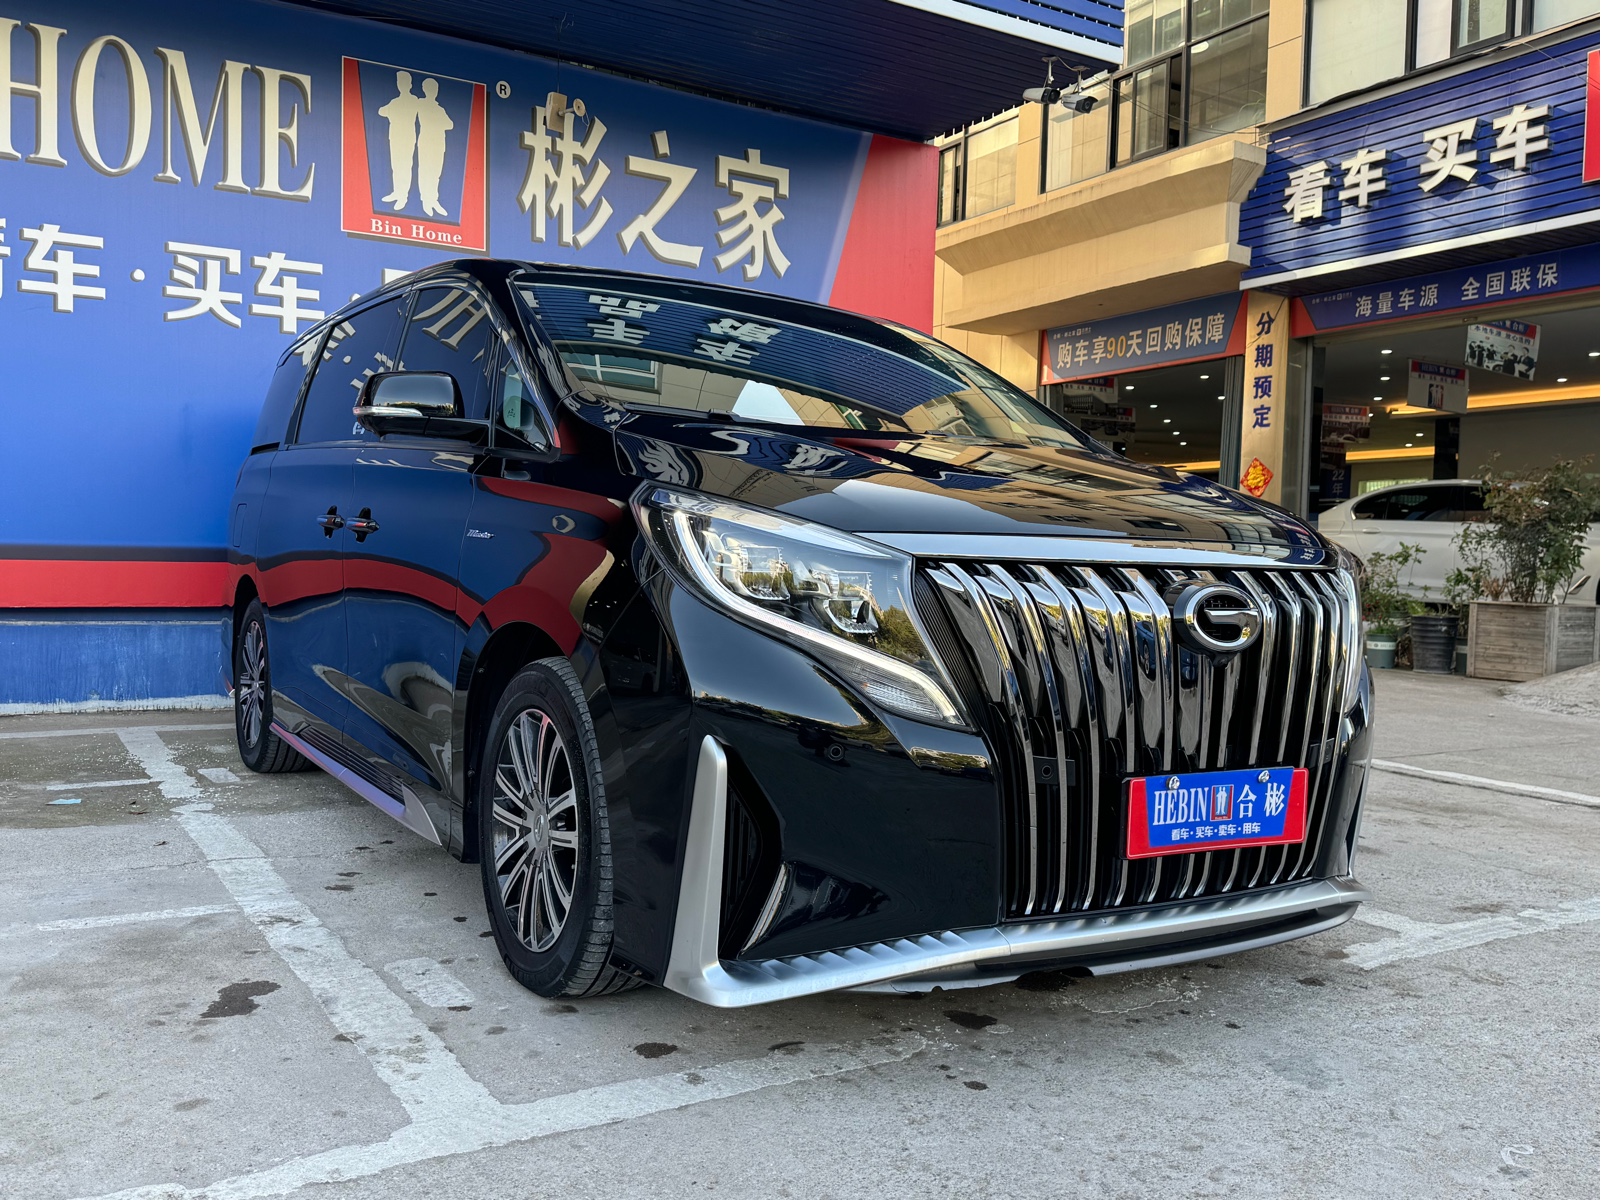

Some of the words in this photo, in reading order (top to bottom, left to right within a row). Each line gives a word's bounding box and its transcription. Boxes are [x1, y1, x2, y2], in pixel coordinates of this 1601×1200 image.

[0, 17, 315, 202] HOME
[517, 104, 792, 282] 彬之家
[1282, 148, 1391, 224] 看车
[1418, 103, 1553, 193] 买车
[369, 218, 403, 237] Bin
[410, 222, 464, 244] Home
[1355, 283, 1439, 318] 海量车源
[1461, 262, 1559, 301] 全国联保
[1056, 312, 1225, 370] 购车享90天回购保障
[1252, 311, 1274, 429] 分期预定
[1153, 787, 1209, 826] HEBIN
[1237, 782, 1286, 819] 合彬
